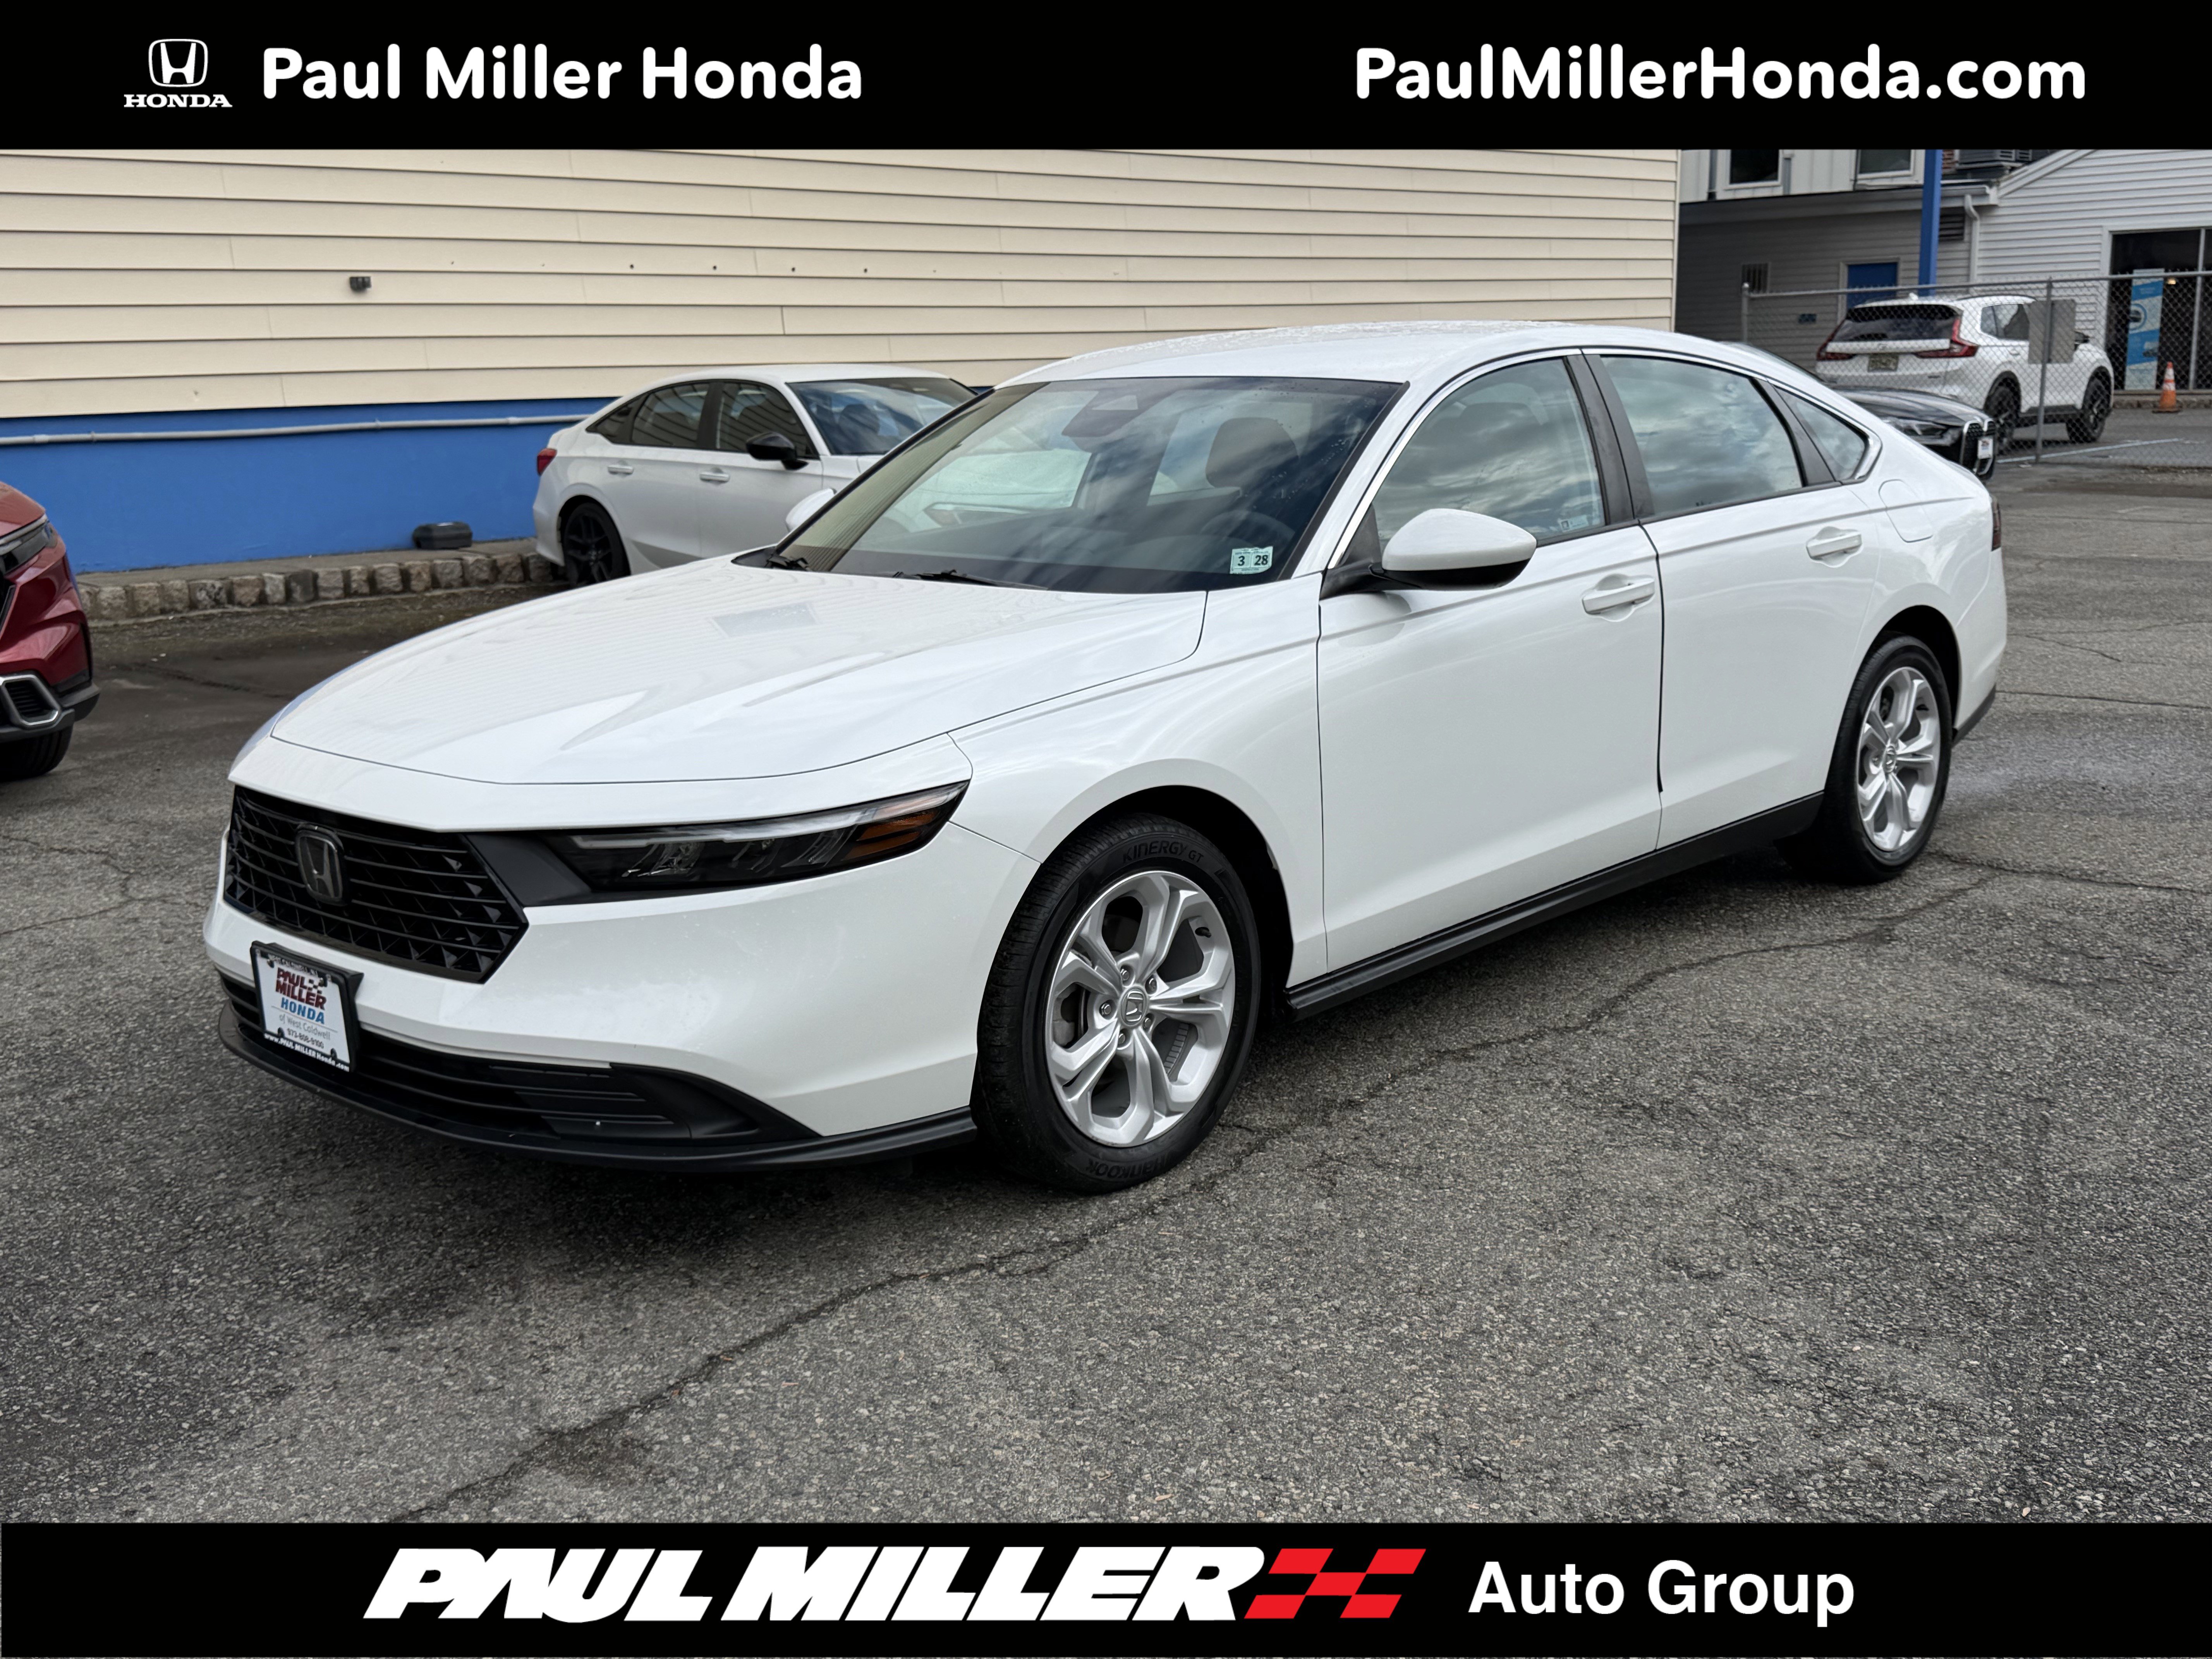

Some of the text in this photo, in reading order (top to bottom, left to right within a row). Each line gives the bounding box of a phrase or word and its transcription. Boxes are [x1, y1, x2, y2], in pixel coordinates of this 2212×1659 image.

[1238, 555, 1268, 566] 3 28
[1188, 850, 1204, 863] GT
[276, 968, 307, 989] PAUL
[276, 981, 326, 1010] MILLER
[281, 997, 325, 1024] HONDA
[279, 1013, 285, 1024] of
[287, 1017, 301, 1030] West
